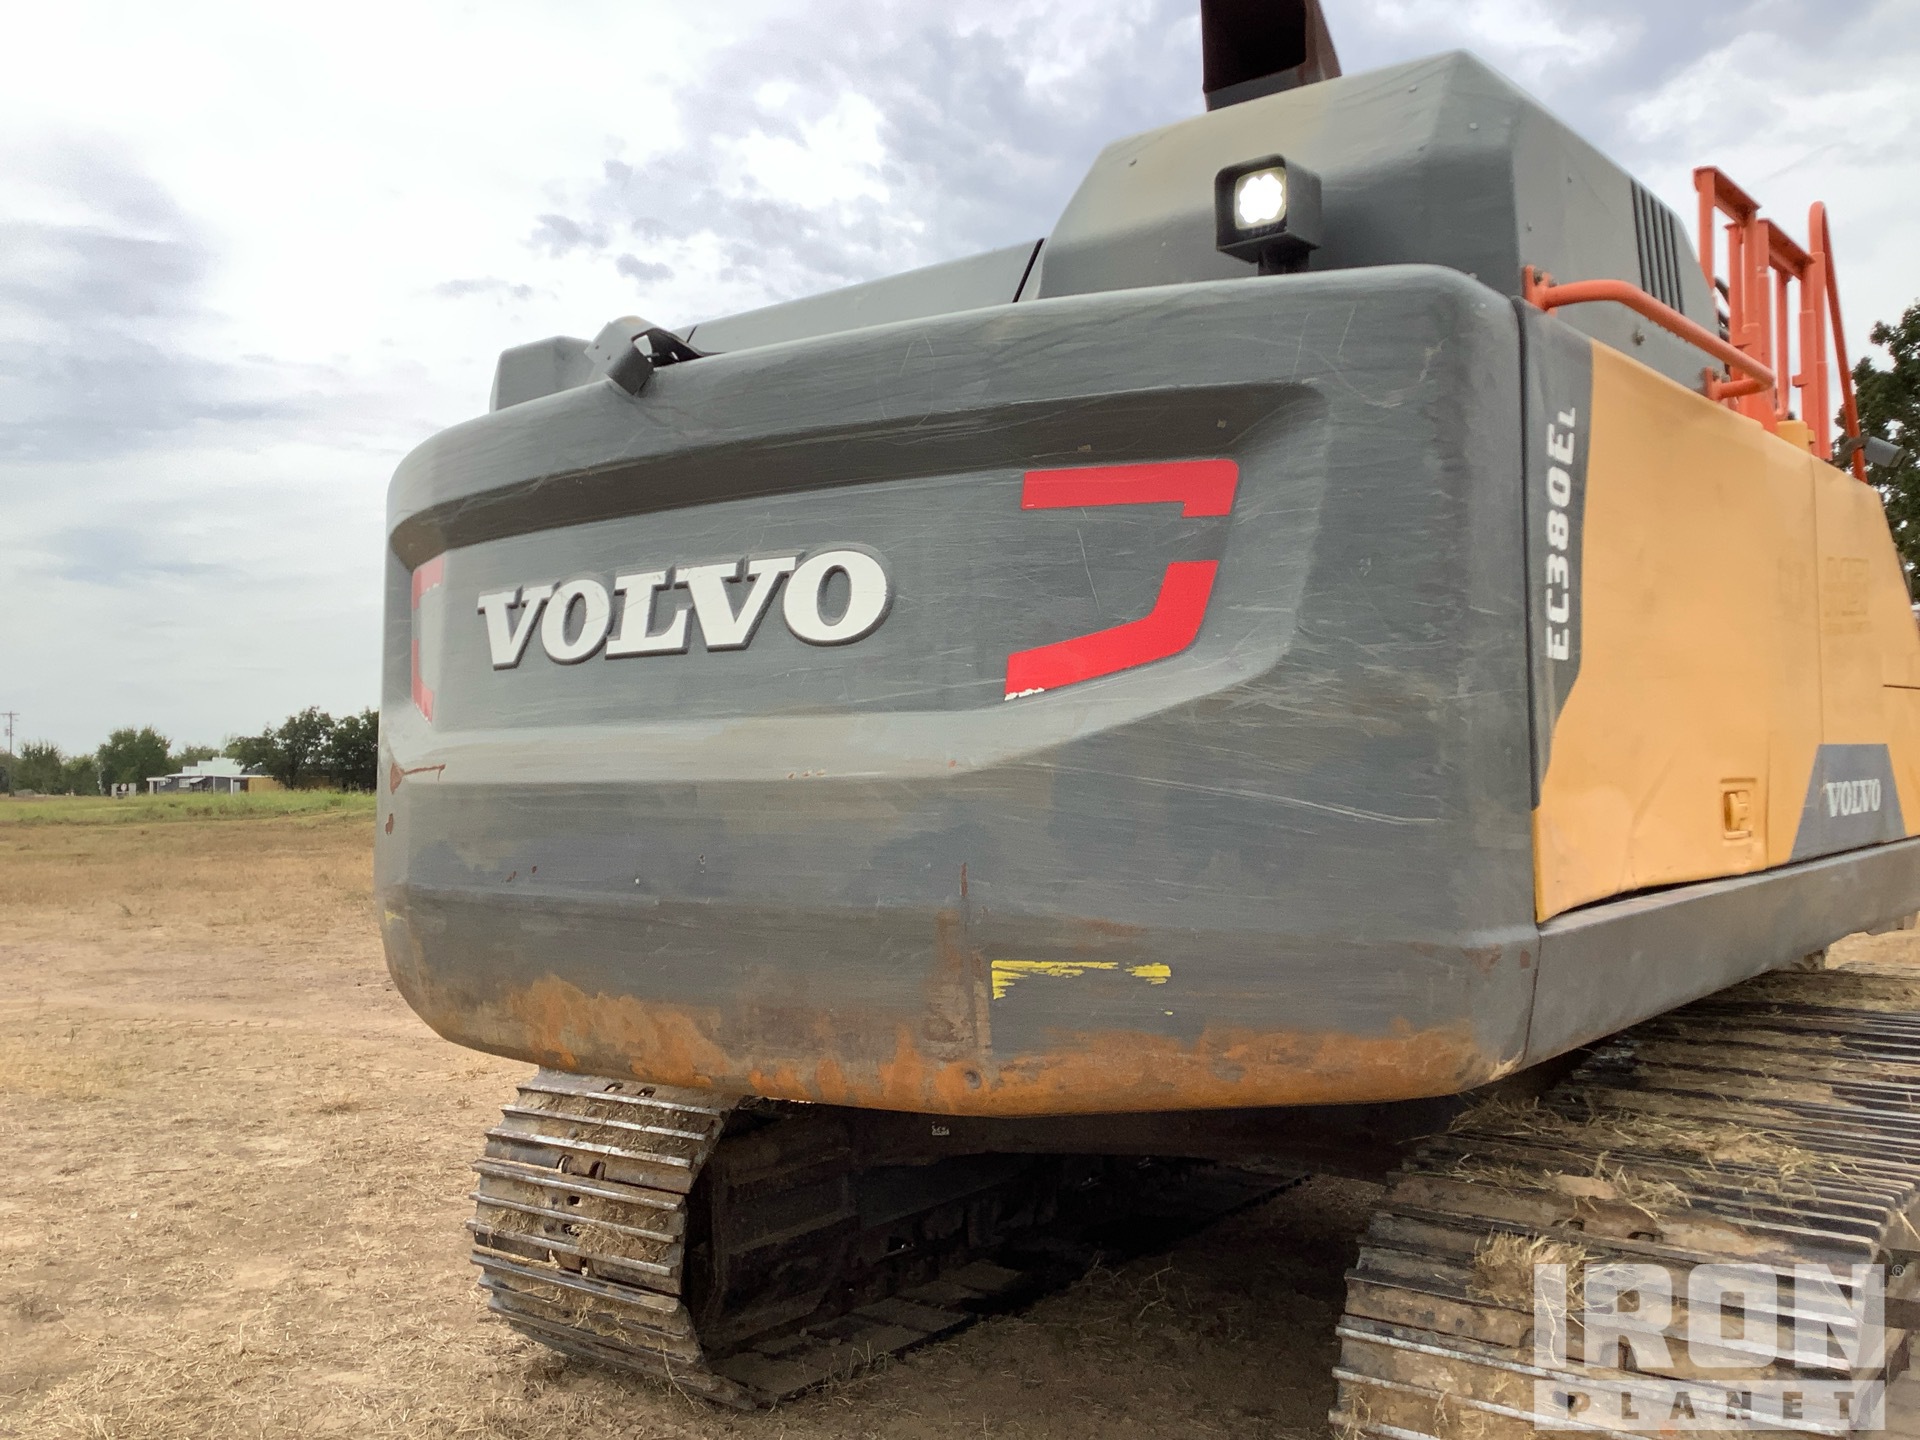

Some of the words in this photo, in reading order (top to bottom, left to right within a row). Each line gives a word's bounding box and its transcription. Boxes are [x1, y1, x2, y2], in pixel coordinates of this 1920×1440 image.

[1546, 407, 1576, 660] EC380EL
[477, 549, 890, 670] VOLVO
[1826, 778, 1881, 817] VOLVO
